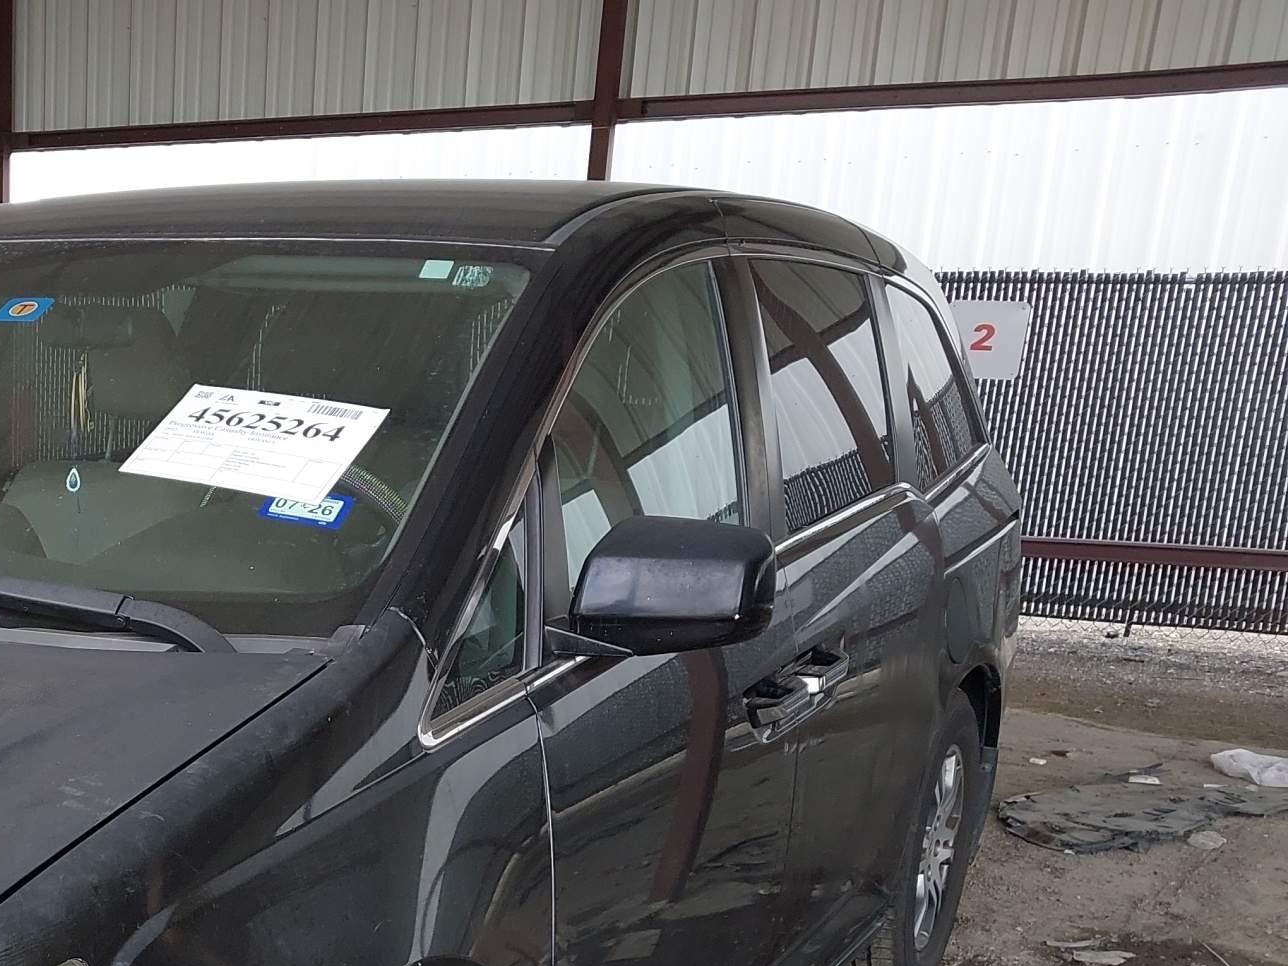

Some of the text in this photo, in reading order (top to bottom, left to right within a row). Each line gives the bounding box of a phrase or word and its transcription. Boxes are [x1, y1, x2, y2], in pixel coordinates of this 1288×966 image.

[970, 323, 996, 351] 2
[187, 406, 347, 442] 45625264
[275, 497, 298, 510] 07
[308, 503, 334, 516] 26
